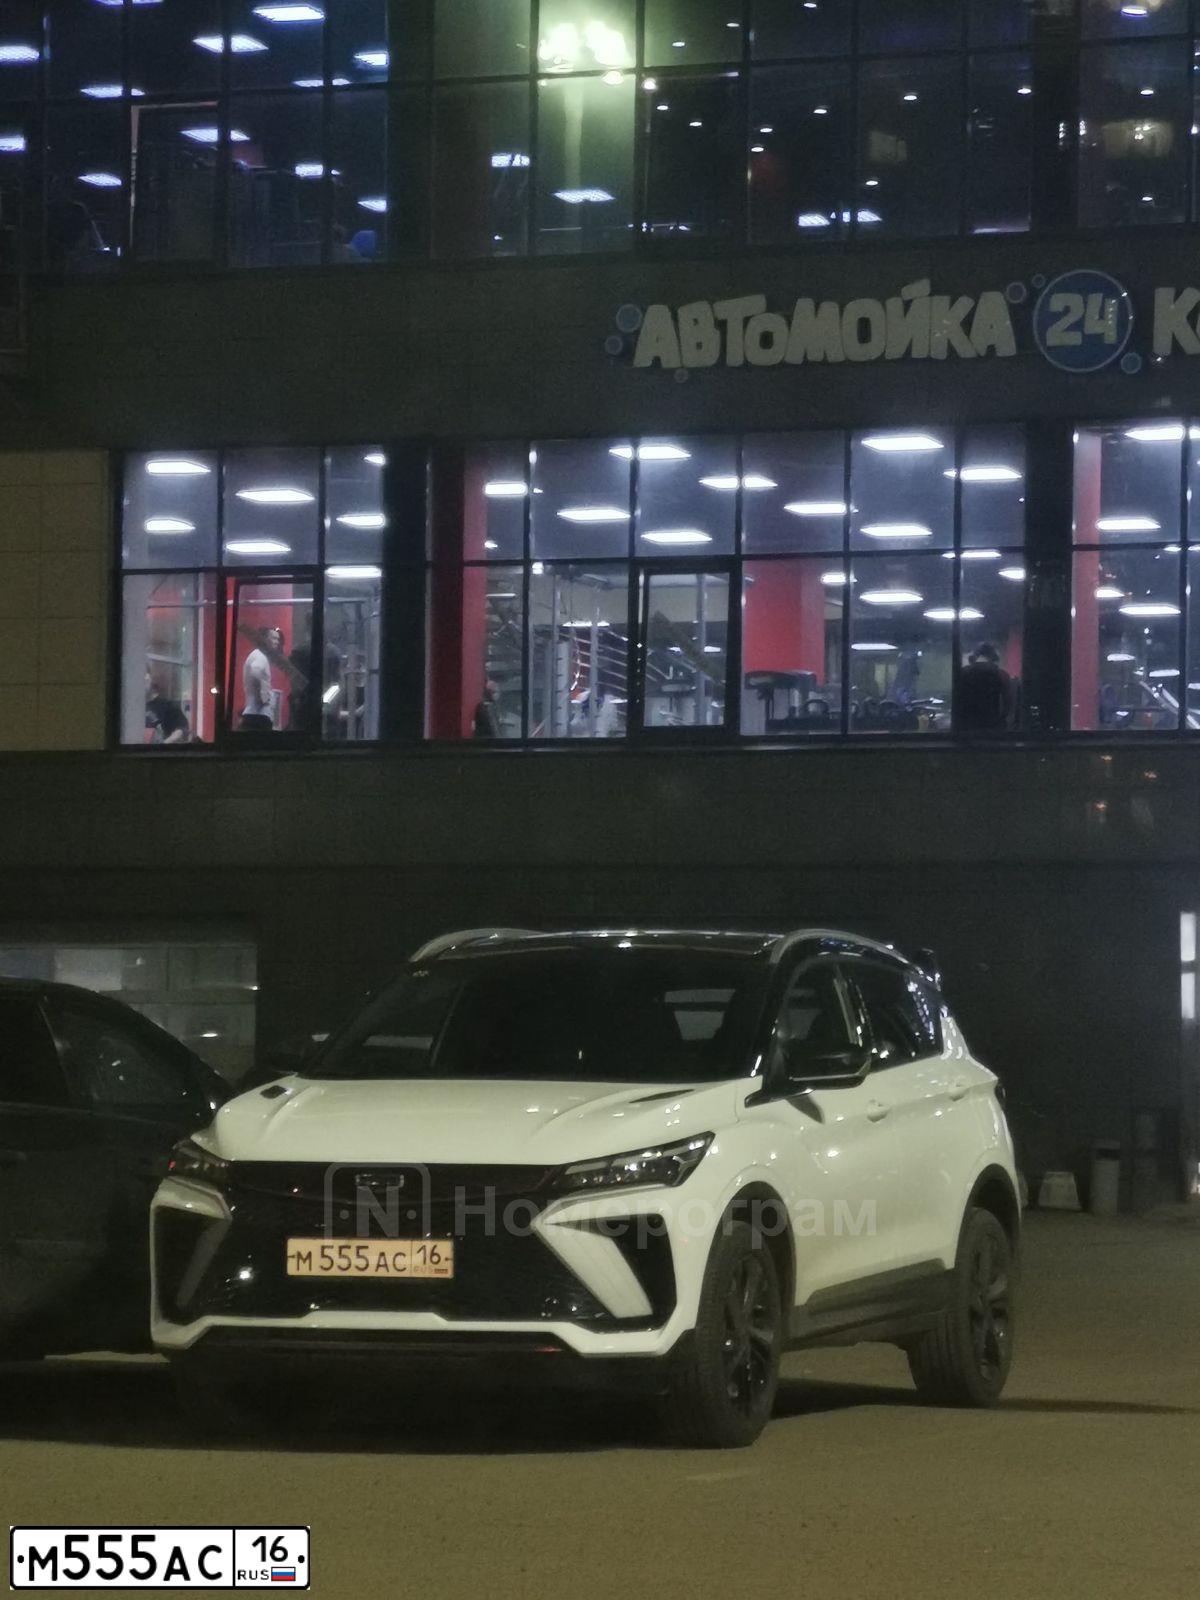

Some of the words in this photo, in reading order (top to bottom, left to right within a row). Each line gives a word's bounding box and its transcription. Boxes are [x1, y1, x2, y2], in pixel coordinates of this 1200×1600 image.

[634, 279, 1016, 369] АВТОМОЙКА
[1046, 292, 1117, 347] 24
[1153, 286, 1200, 356] К
[416, 1244, 441, 1265] 16
